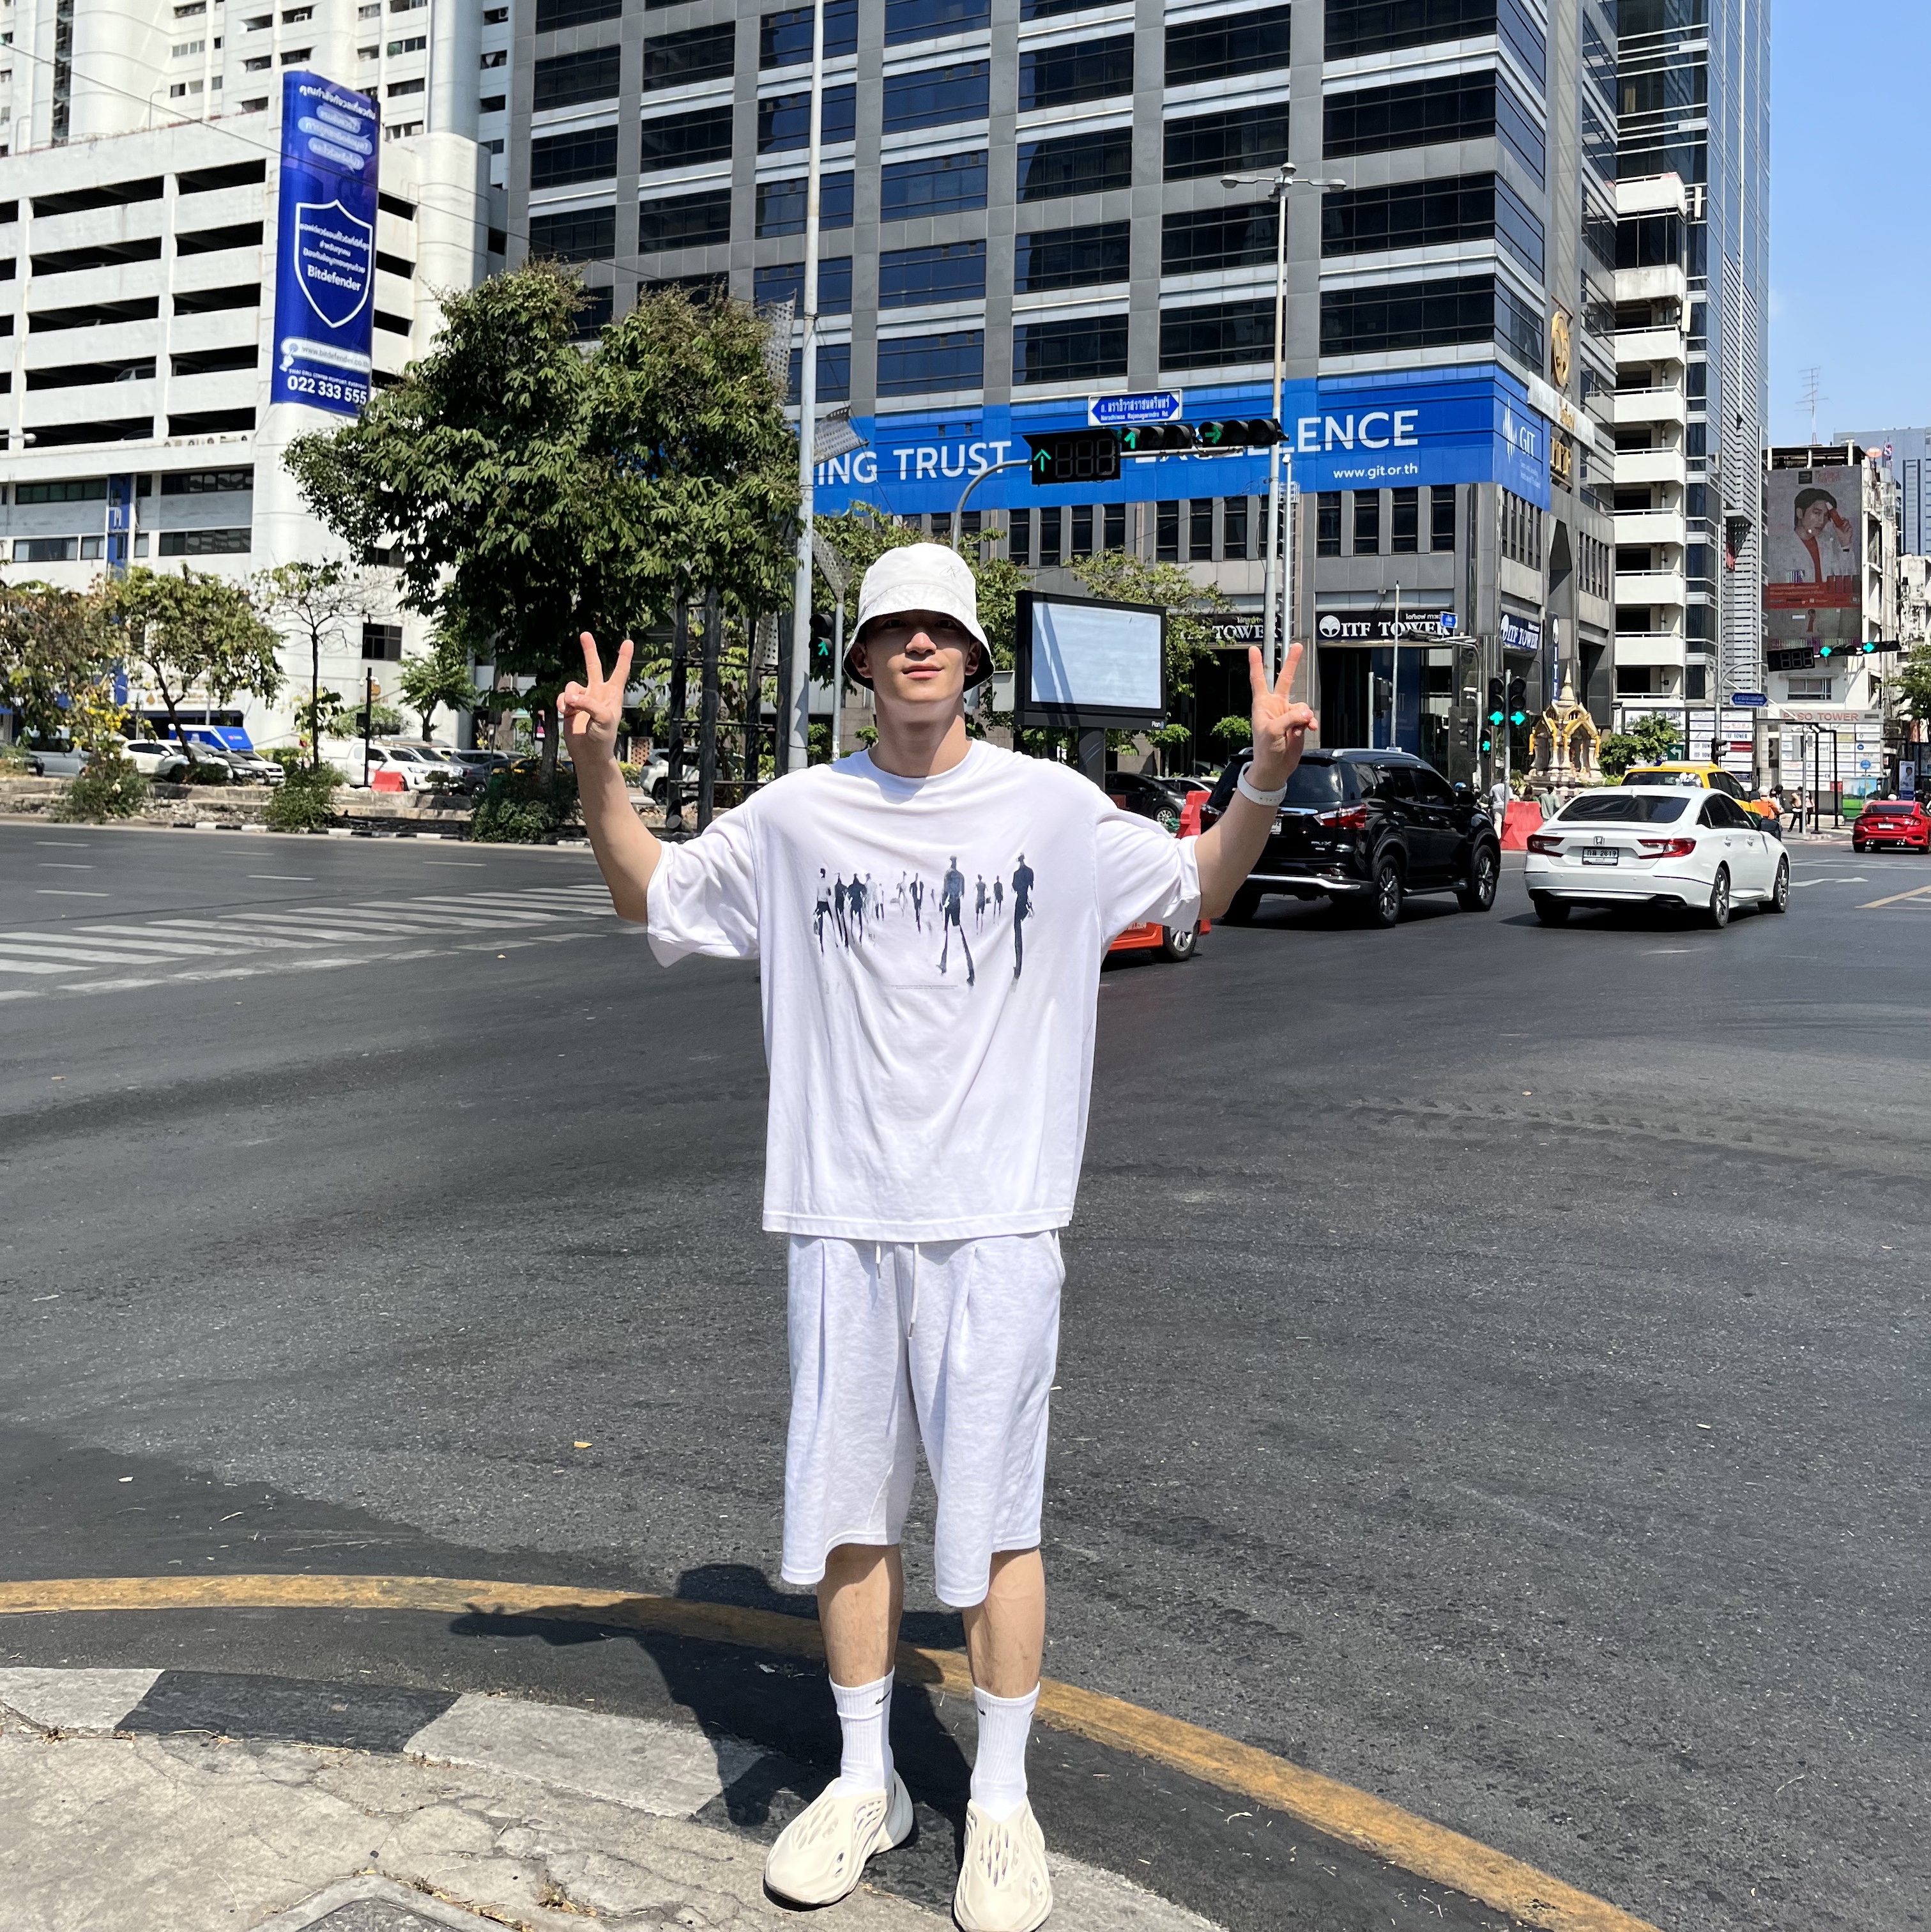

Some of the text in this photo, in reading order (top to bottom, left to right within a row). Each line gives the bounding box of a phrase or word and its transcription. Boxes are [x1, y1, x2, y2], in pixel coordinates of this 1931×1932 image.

[308, 264, 362, 291] Bitdefender
[301, 346, 369, 369] www.bitdefender.co.th
[287, 375, 367, 405] 022 333 555
[1520, 426, 1536, 459] GIT
[818, 451, 878, 486] ING
[893, 440, 1012, 480] TRUST
[1333, 462, 1418, 480] www.git.or.th
[1341, 621, 1450, 637] ITF TOWER
[1506, 625, 1519, 643] ITF
[1518, 628, 1539, 649] TOWER
[1817, 712, 1859, 721] TOWER
